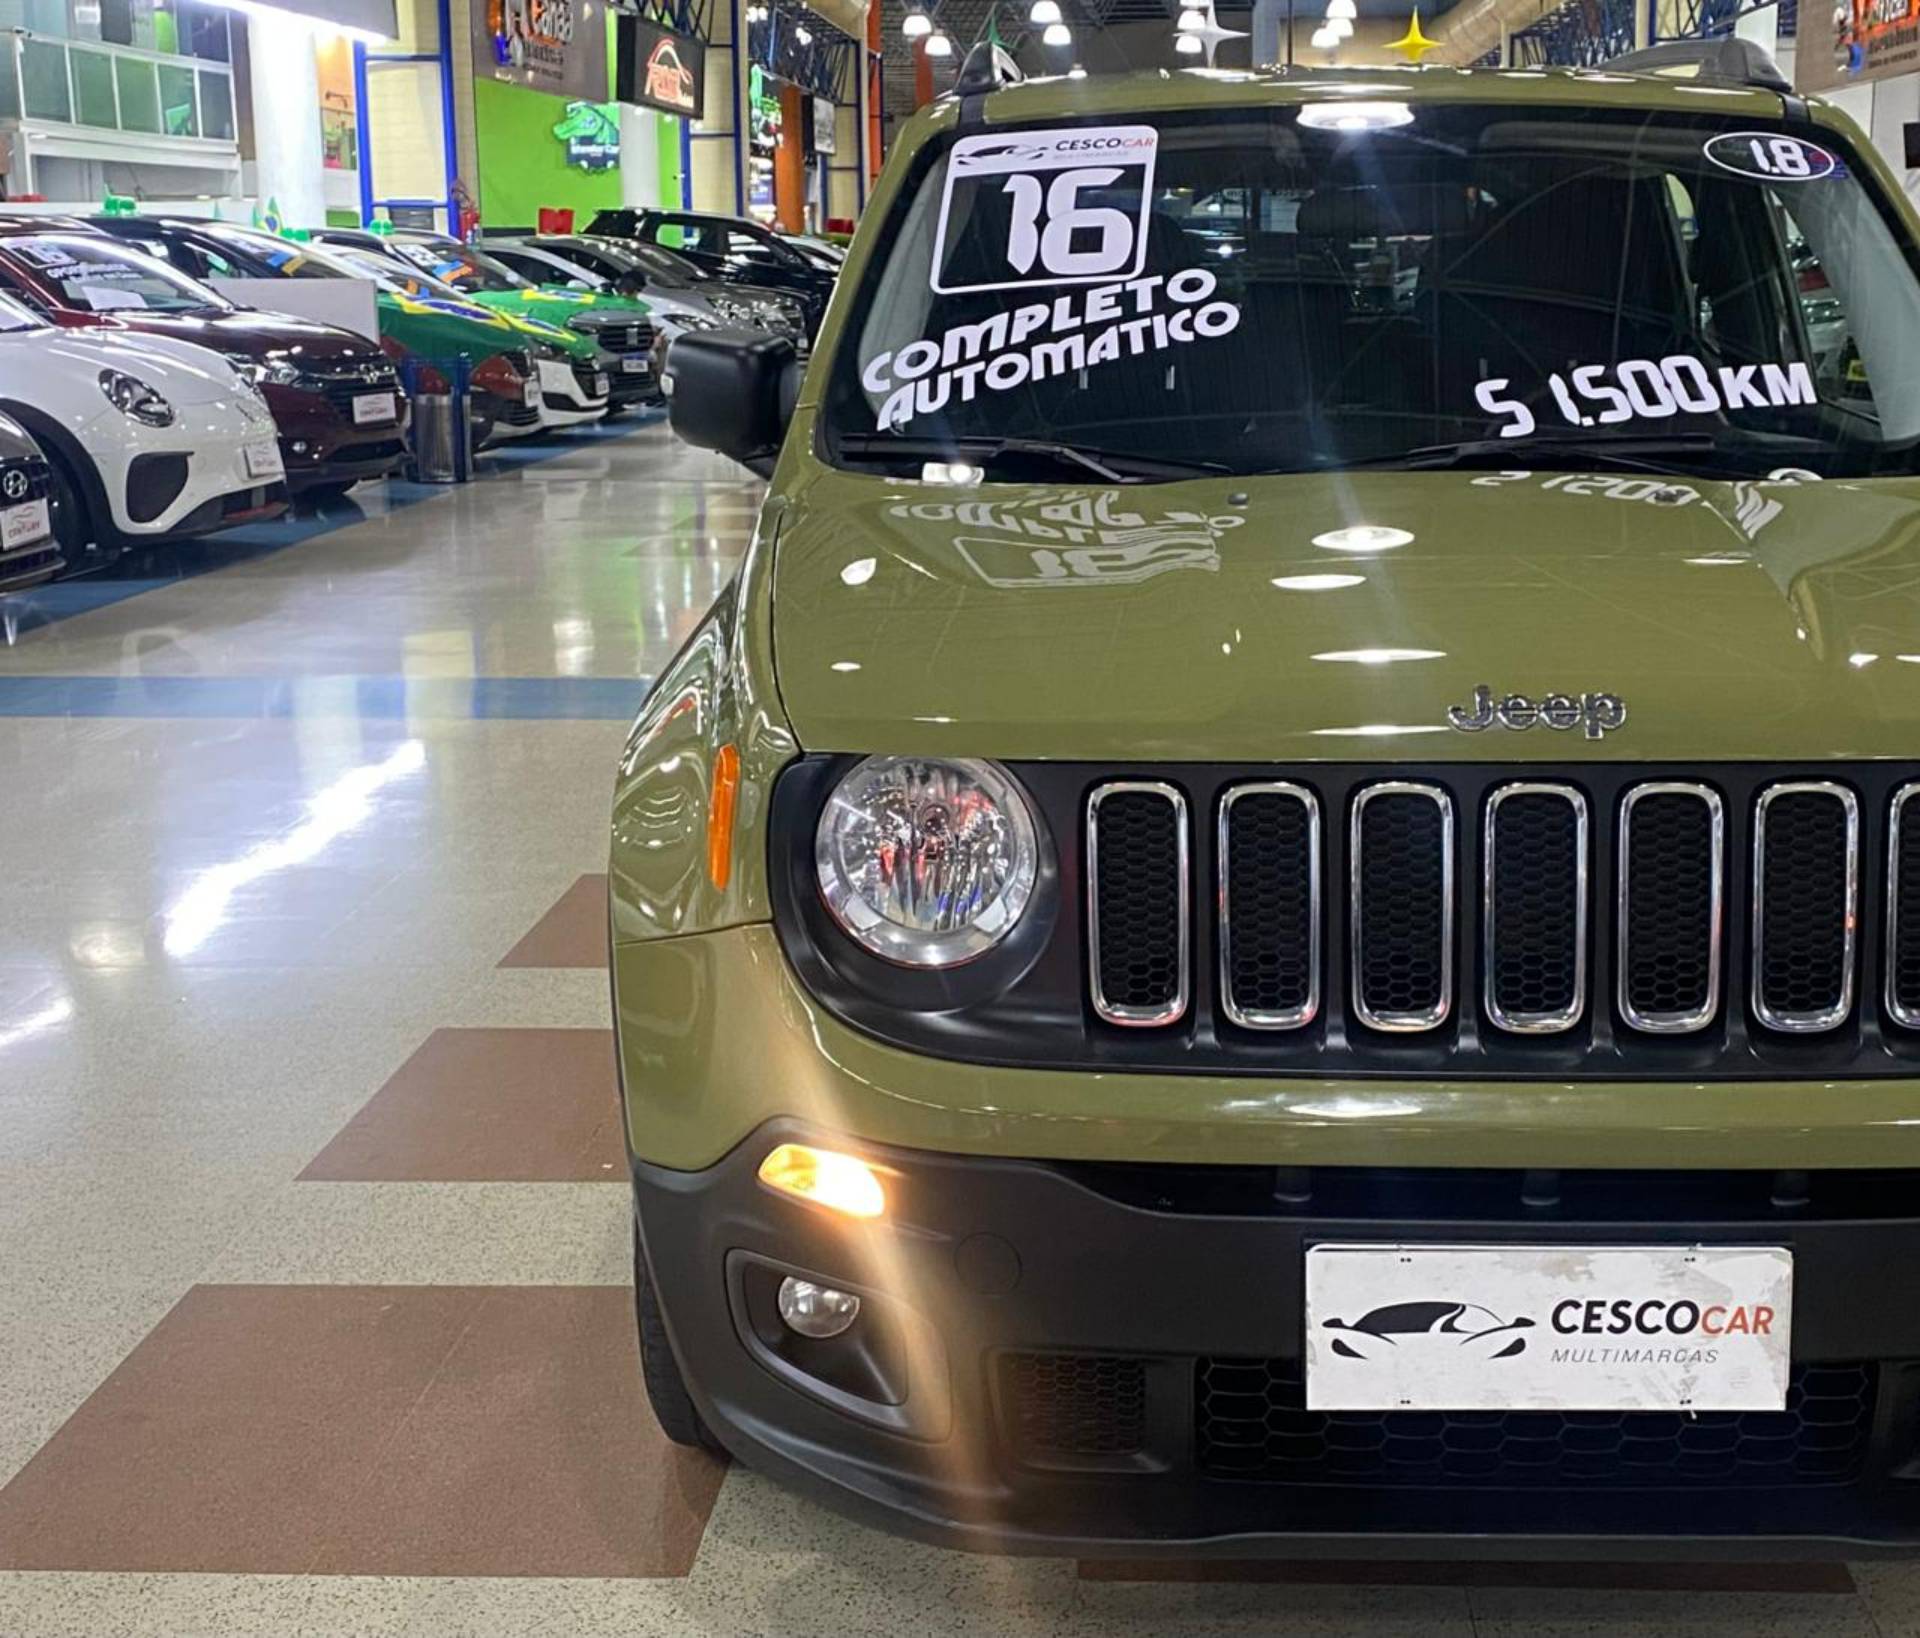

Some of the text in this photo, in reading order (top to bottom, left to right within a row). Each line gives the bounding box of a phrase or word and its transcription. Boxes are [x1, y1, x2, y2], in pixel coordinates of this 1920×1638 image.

[1055, 137, 1154, 151] CESCOCAR
[1749, 138, 1811, 175] 1.8
[1001, 167, 1134, 276] 16
[861, 268, 1218, 394] COMPLETO
[876, 301, 1241, 431] AUTOMATICO
[1448, 684, 1627, 740] Jeep
[1551, 1298, 1774, 1336] CESCOCAR
[1551, 1348, 1719, 1365] MULTIMARCAS
